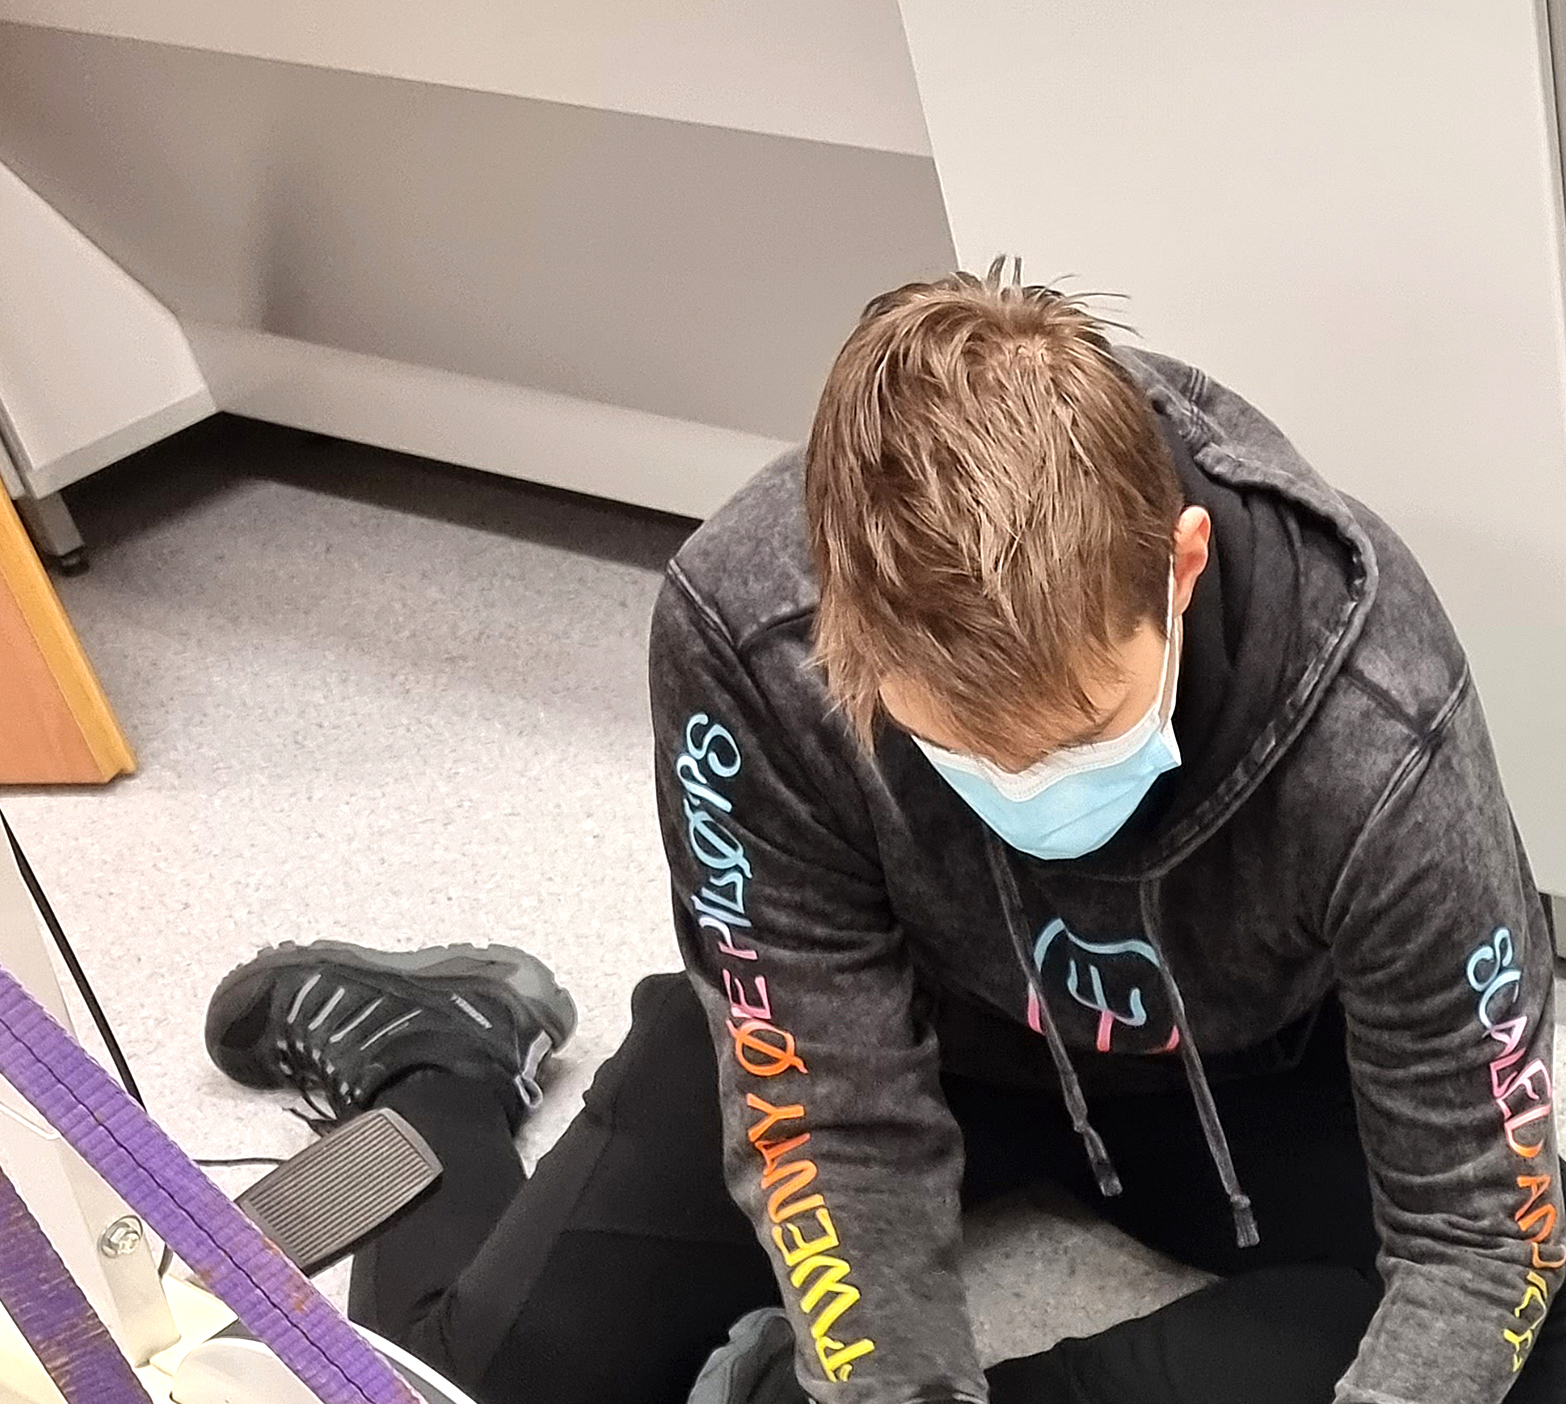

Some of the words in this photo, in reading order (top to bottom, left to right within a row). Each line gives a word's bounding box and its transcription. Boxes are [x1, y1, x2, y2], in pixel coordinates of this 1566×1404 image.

[722, 968, 809, 1076] ØE
[1466, 926, 1552, 1159] SCALED
[746, 1092, 875, 1383] TWENTY
